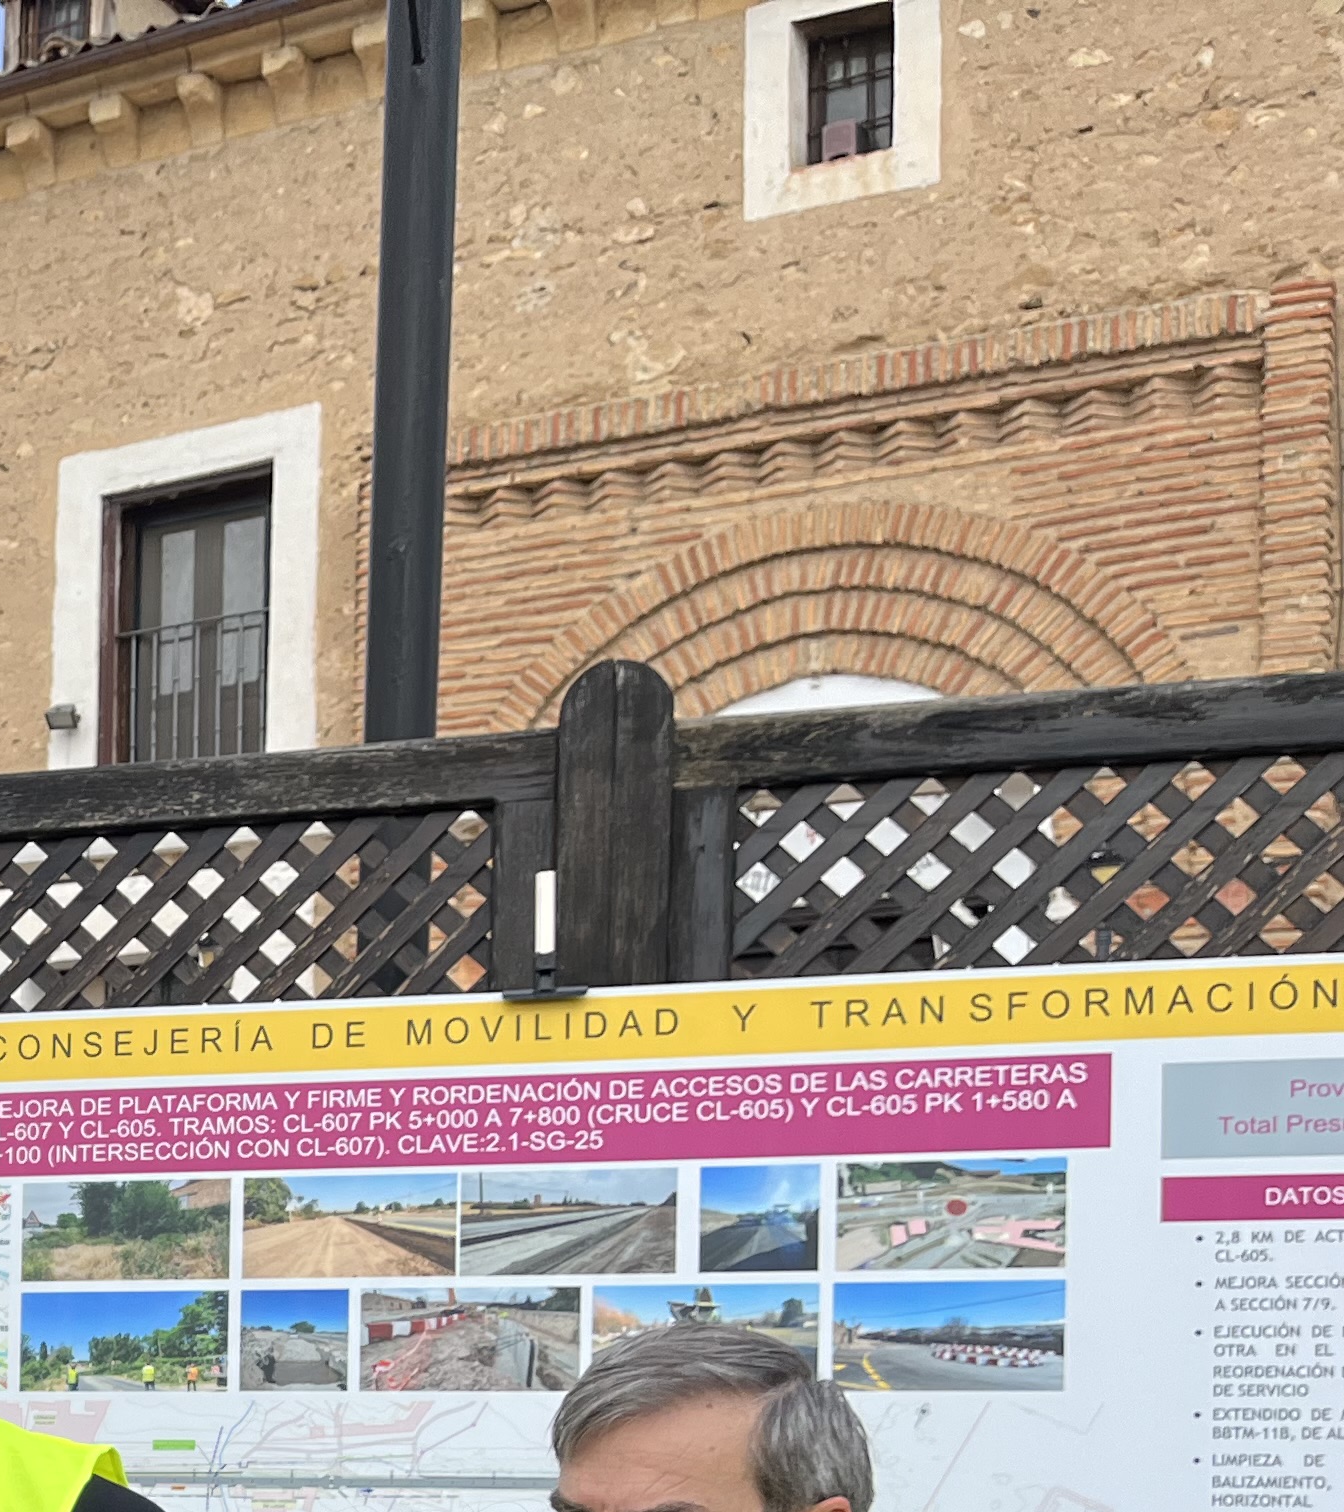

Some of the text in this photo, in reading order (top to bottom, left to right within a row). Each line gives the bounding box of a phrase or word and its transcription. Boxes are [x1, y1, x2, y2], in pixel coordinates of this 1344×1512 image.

[312, 1021, 366, 1050] DE
[406, 1007, 679, 1045] MOVILIDAD
[733, 1004, 757, 1032] Y
[81, 1097, 112, 1117] DE
[118, 1092, 278, 1115] PLATAFORMA
[284, 1091, 302, 1111] Y
[308, 1088, 382, 1110] FIRME
[388, 1087, 407, 1107] Y
[413, 1077, 600, 1106] RORDENACIÓN
[608, 1078, 645, 1100] DE
[650, 1072, 783, 1098] ACCESOS
[790, 1071, 828, 1093] DE
[835, 1069, 887, 1091] LAS
[894, 1061, 1089, 1090] CARRETERAS
[58, 1120, 75, 1140] Y
[80, 1117, 162, 1140] CL-605.
[169, 1113, 277, 1137] TRAMOS:
[282, 1112, 362, 1133] CL-607
[369, 1109, 402, 1131] PK
[409, 1108, 478, 1129] 5+000
[484, 1108, 502, 1127] A
[508, 1105, 581, 1127] 7+800
[587, 1102, 689, 1129] (CRUCE
[695, 1098, 794, 1123] CL-605)
[800, 1098, 816, 1118] Y
[826, 1093, 919, 1117] CL-605
[924, 1091, 963, 1113] PK
[972, 1089, 1050, 1112] 1+580
[1056, 1089, 1078, 1110] A
[1218, 1114, 1344, 1135] Total Pres
[48, 1137, 230, 1168] (INTERSECCIÓN
[236, 1138, 291, 1159] CON
[296, 1135, 391, 1161] CL-607).
[1264, 1186, 1344, 1206] DATOS
[1215, 1231, 1240, 1246] 2,8
[1251, 1231, 1274, 1243] KM
[1284, 1230, 1306, 1243] DE
[1215, 1248, 1274, 1262] CL-605.
[1214, 1272, 1344, 1289] MEJORA SECCIÓ
[1214, 1294, 1336, 1311] A SECCIÓN 7/9.
[1213, 1321, 1301, 1338] EJECUCIÓN
[1312, 1325, 1333, 1338] DE
[1213, 1343, 1335, 1357] OTRA EN EL
[1213, 1362, 1334, 1378] REORDENACIÓN
[1213, 1383, 1309, 1397] DE SERVICIO
[1212, 1407, 1301, 1421] EXTENDIDO
[1311, 1407, 1332, 1421] DE
[1301, 1426, 1322, 1440] DE
[1212, 1453, 1325, 1467] LIMPIEZA DE
[1212, 1475, 1332, 1491] BALIZAMIENTO,
[1211, 1494, 1313, 1508] HORIZONTAL
